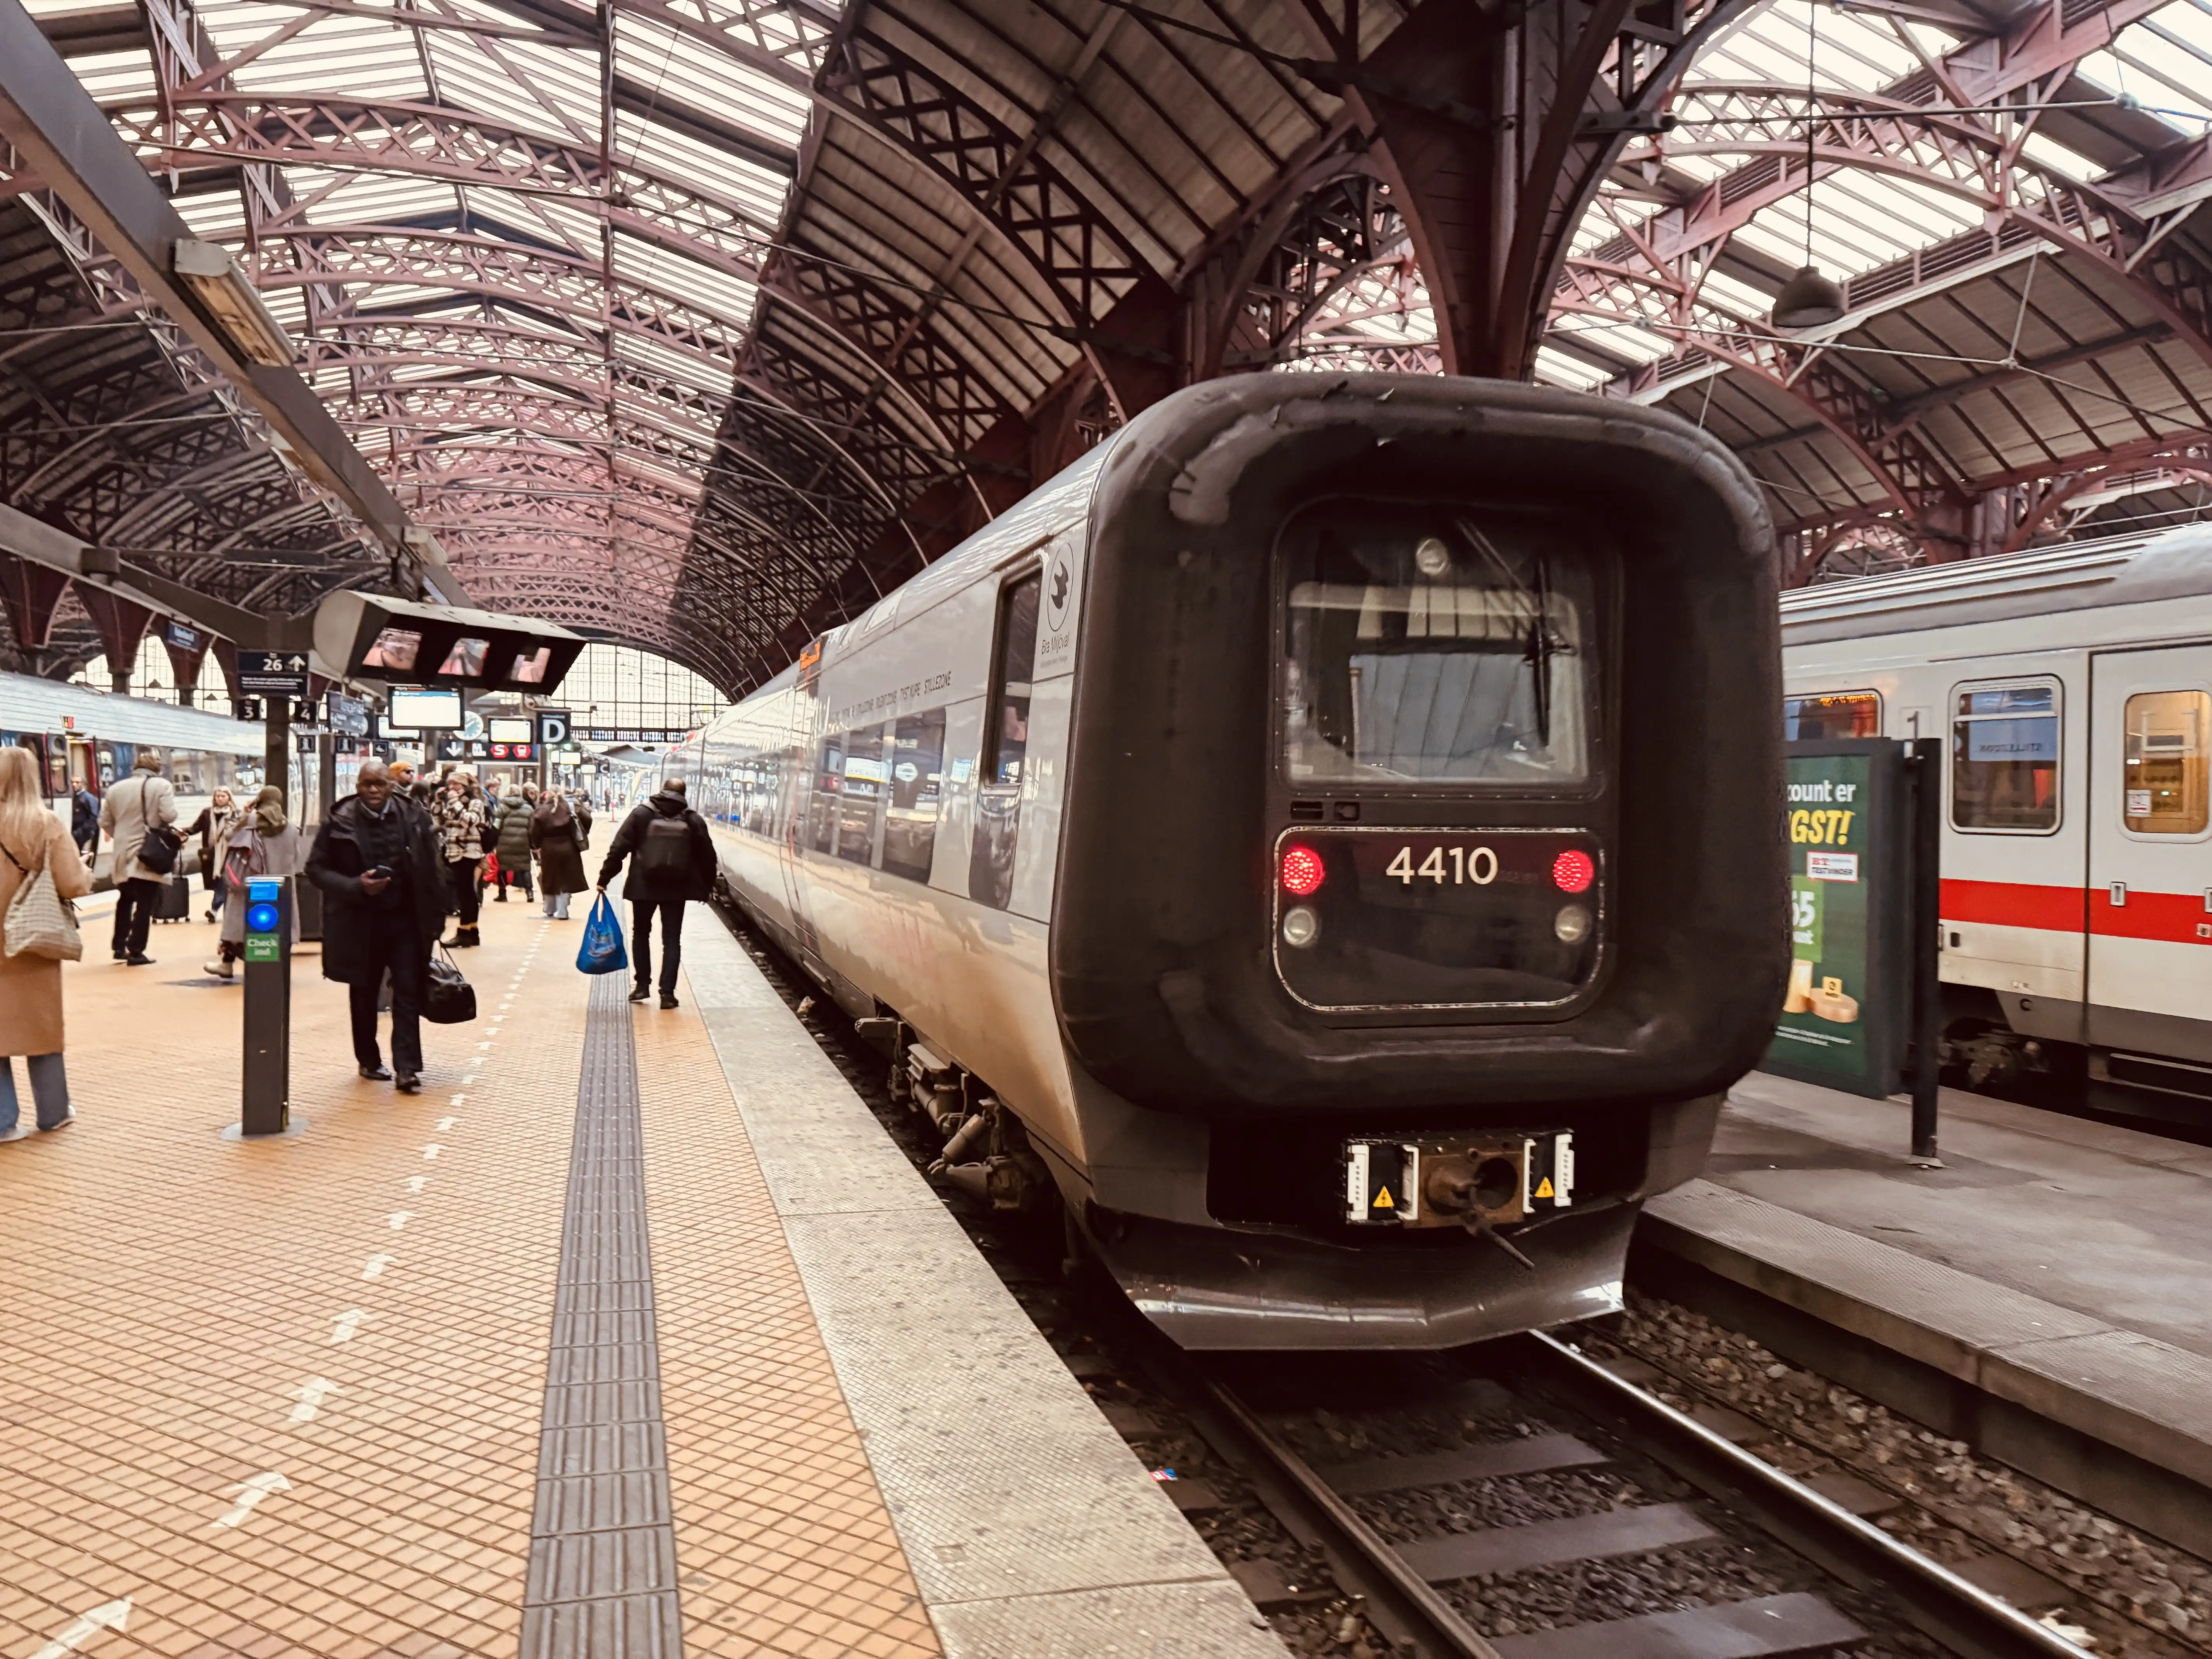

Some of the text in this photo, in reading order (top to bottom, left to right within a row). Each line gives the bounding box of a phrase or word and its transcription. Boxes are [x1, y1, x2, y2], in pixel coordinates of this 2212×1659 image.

[1042, 639, 1050, 654] Bra
[263, 659, 283, 671] 26
[244, 706, 254, 718] 3
[300, 708, 310, 720] 4
[543, 719, 565, 743] D
[1907, 711, 1919, 740] 1
[493, 745, 505, 756] S
[600, 764, 608, 773] C
[1834, 784, 1856, 802] er
[1789, 809, 1856, 845] GST!
[1386, 847, 1498, 884] 4410
[2020, 998, 2033, 1011] C
